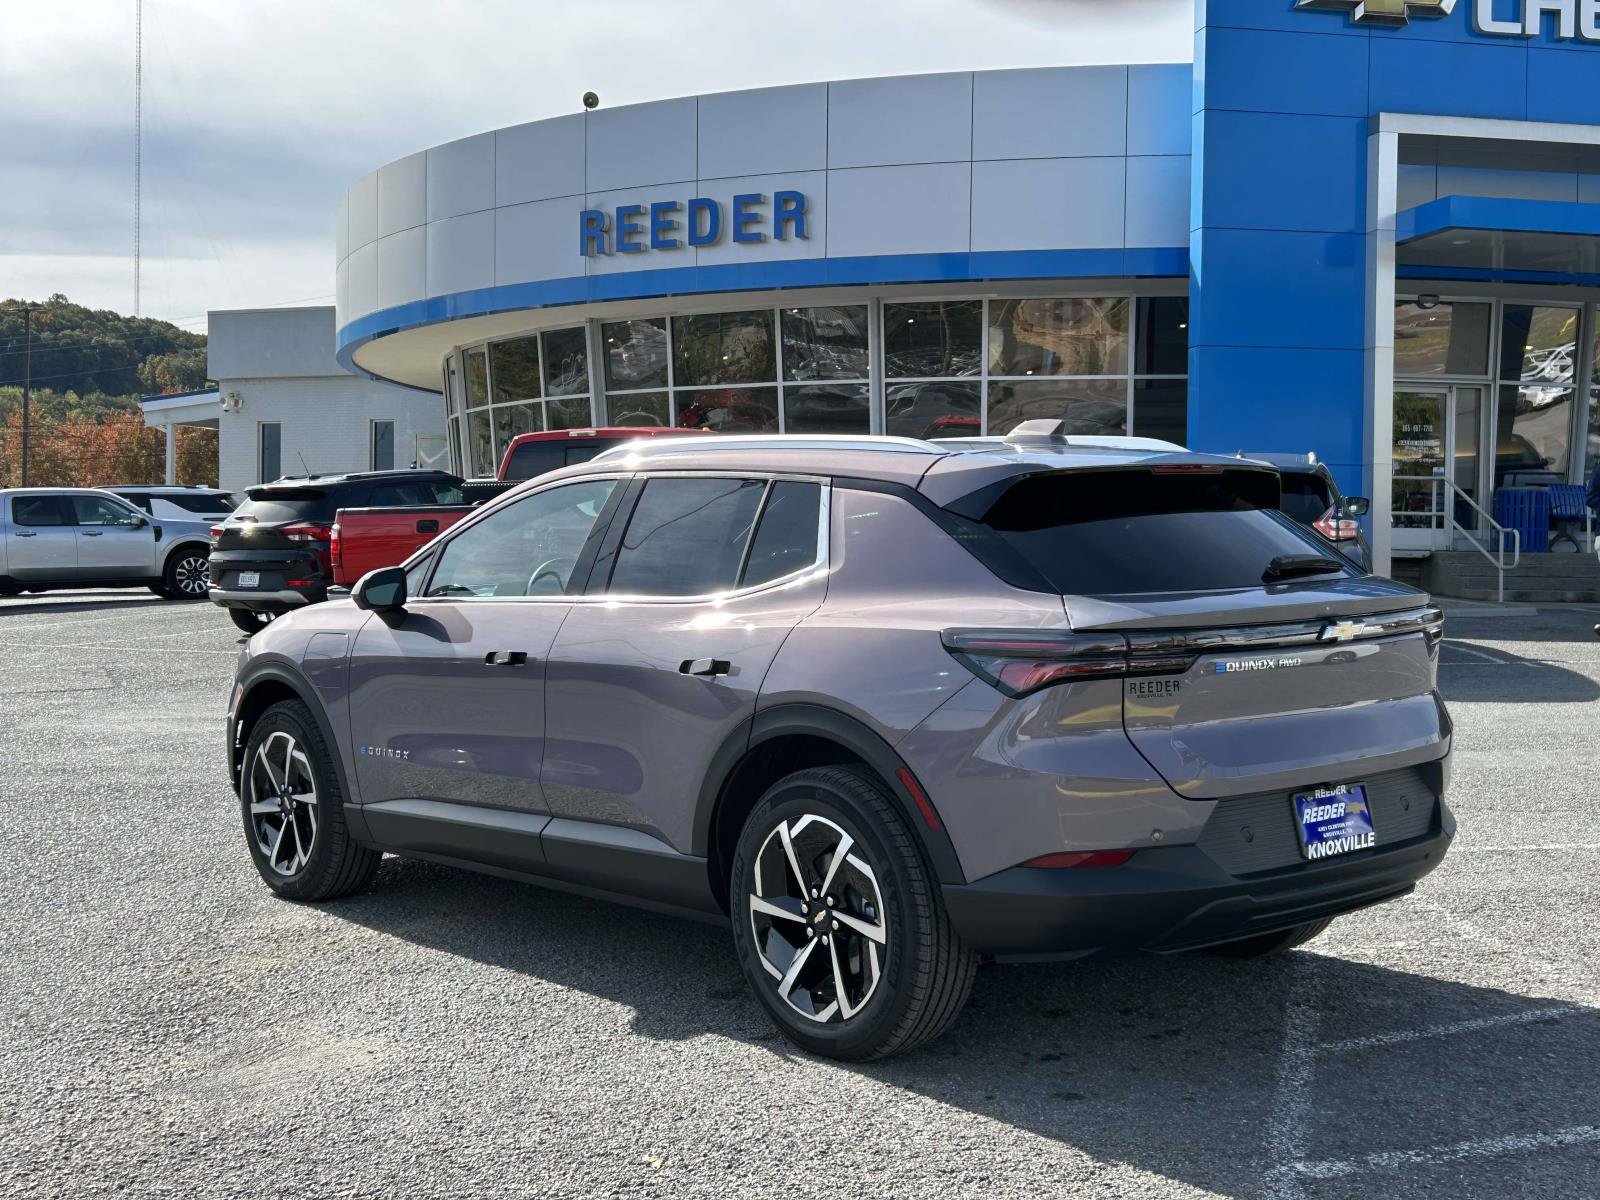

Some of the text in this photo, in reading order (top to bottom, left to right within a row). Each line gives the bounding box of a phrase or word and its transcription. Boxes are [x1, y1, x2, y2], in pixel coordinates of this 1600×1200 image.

[580, 190, 807, 256] REEDER
[1215, 658, 1301, 673] EQUINOX AWD
[1129, 680, 1180, 695] REEDER
[360, 746, 409, 759] EQUINOX
[1315, 785, 1346, 799] REEDER
[1303, 802, 1345, 824] REEDER
[1308, 832, 1375, 860] KNOXVILLE
